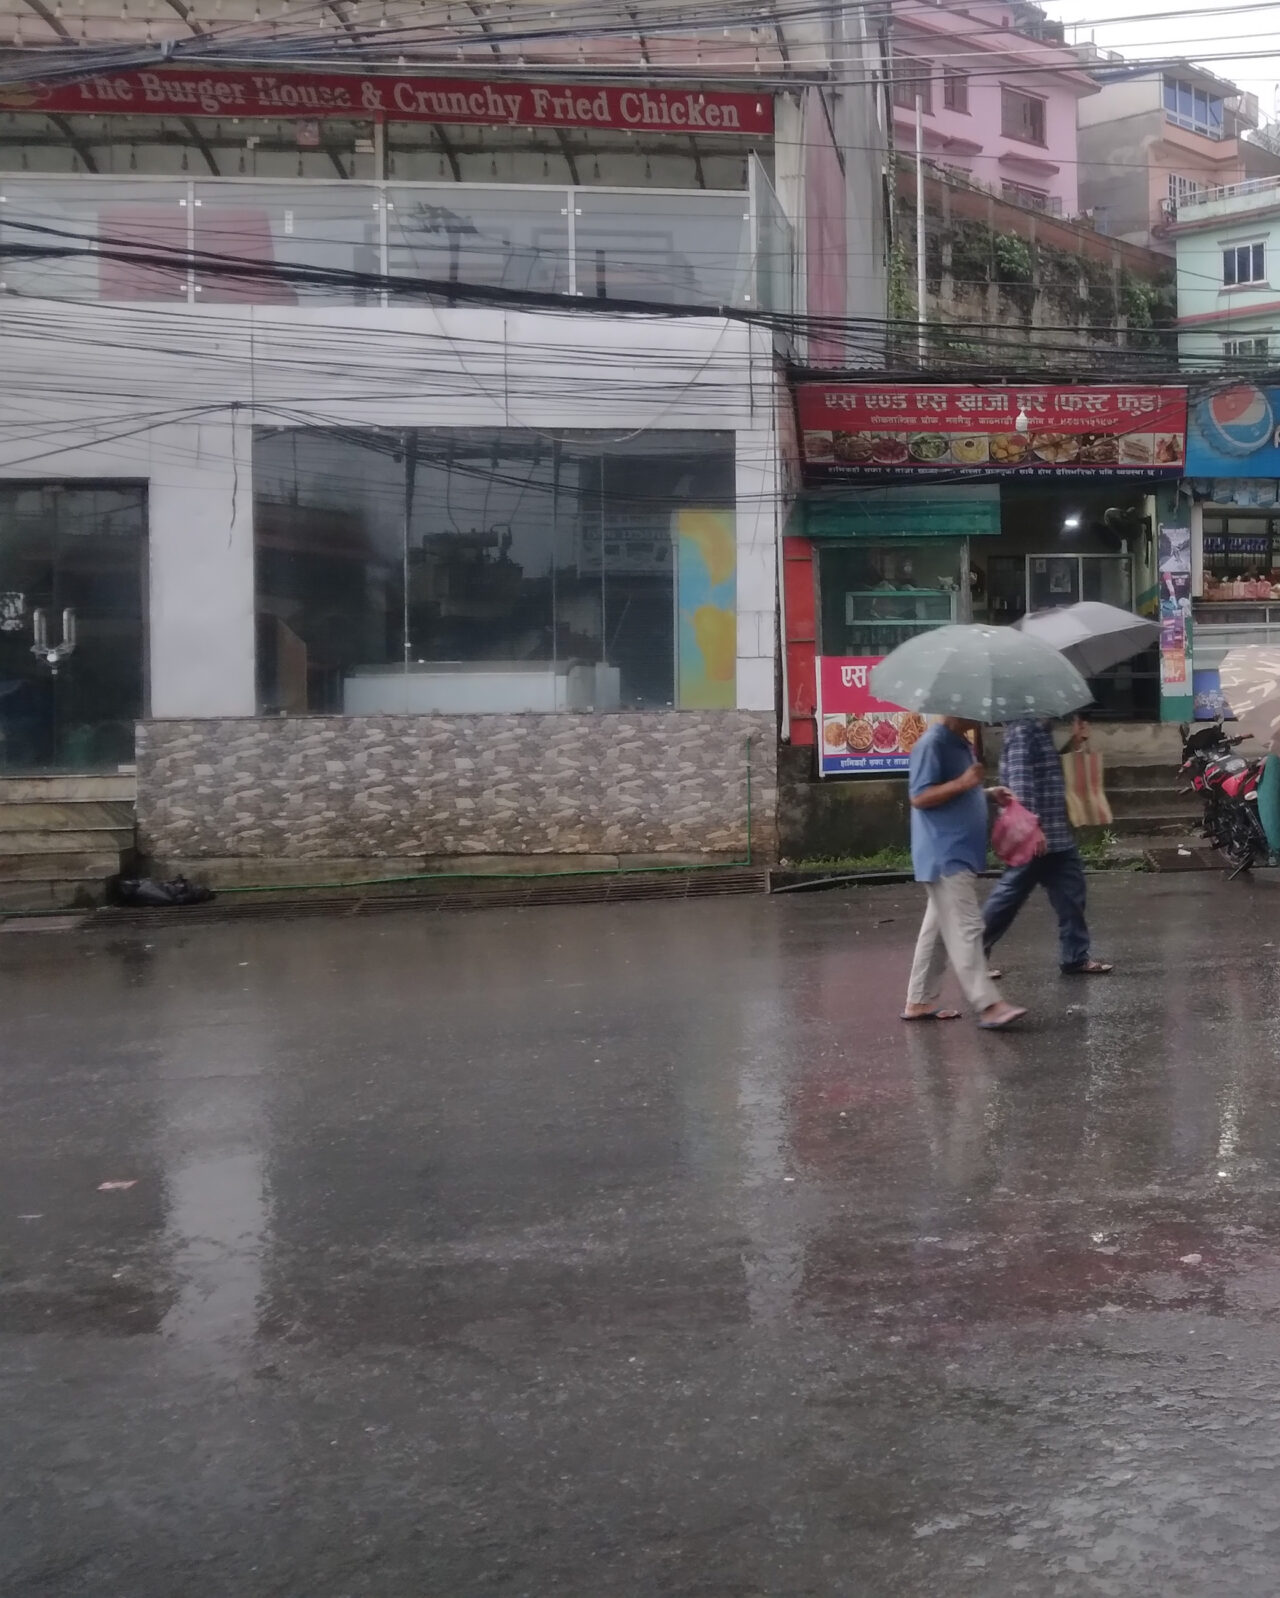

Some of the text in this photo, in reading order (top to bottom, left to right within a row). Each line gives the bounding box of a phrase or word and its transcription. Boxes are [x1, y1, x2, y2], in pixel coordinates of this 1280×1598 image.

[80, 72, 741, 128] The Burger House & Crunchy Fried Chicken
[824, 393, 857, 411] एस
[864, 393, 908, 409] एण्ड
[915, 393, 948, 412] एस
[955, 393, 1009, 412] खाजा
[1016, 393, 1048, 412] घर
[840, 665, 868, 689] एस
